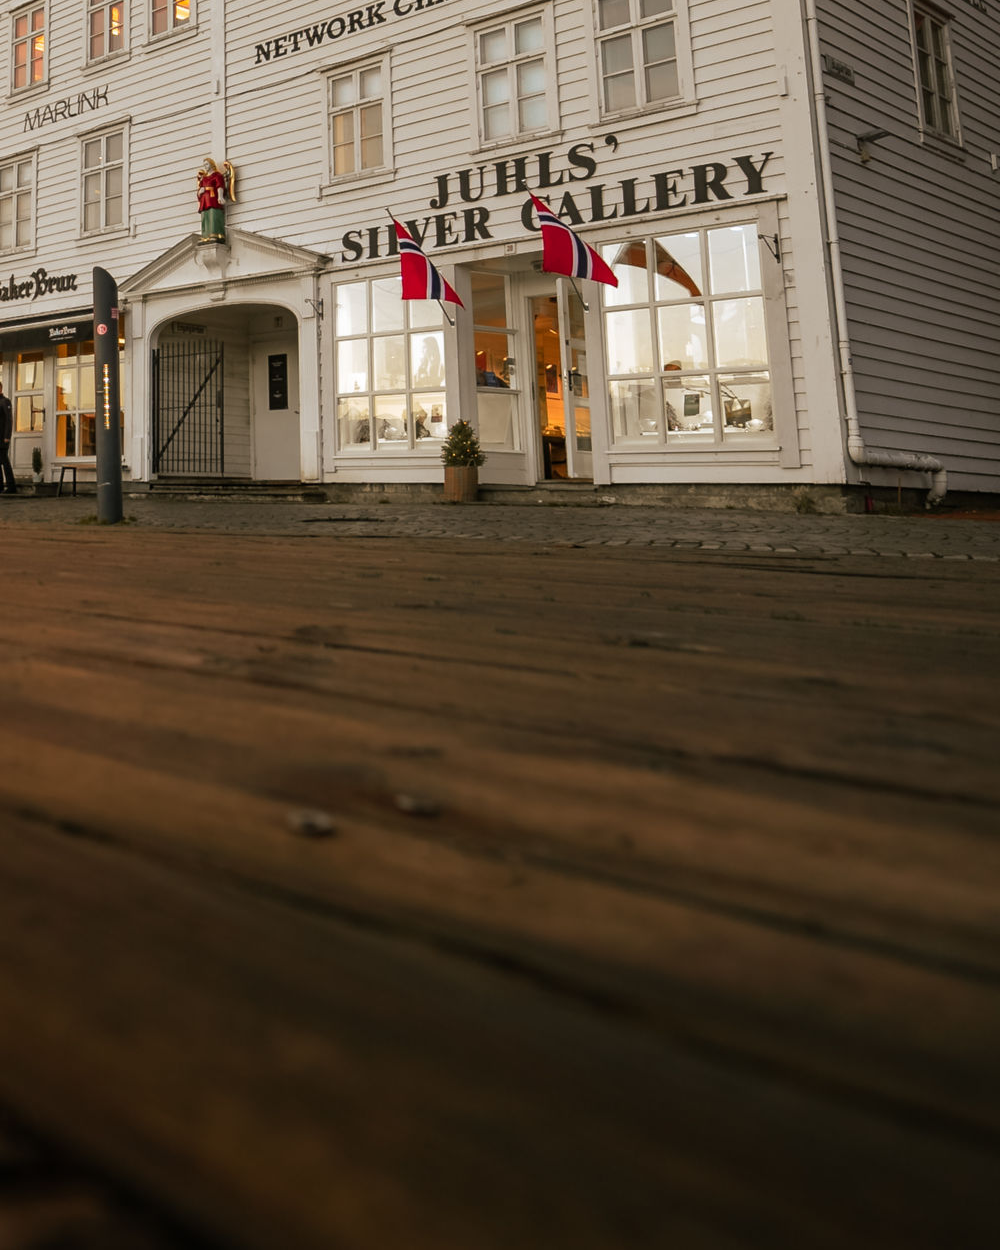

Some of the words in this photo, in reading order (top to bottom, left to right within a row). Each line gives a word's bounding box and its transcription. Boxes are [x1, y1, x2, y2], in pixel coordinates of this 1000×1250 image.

[254, 1, 387, 65] NETWORK
[23, 83, 109, 133] MARLINK
[31, 267, 78, 302] Brun
